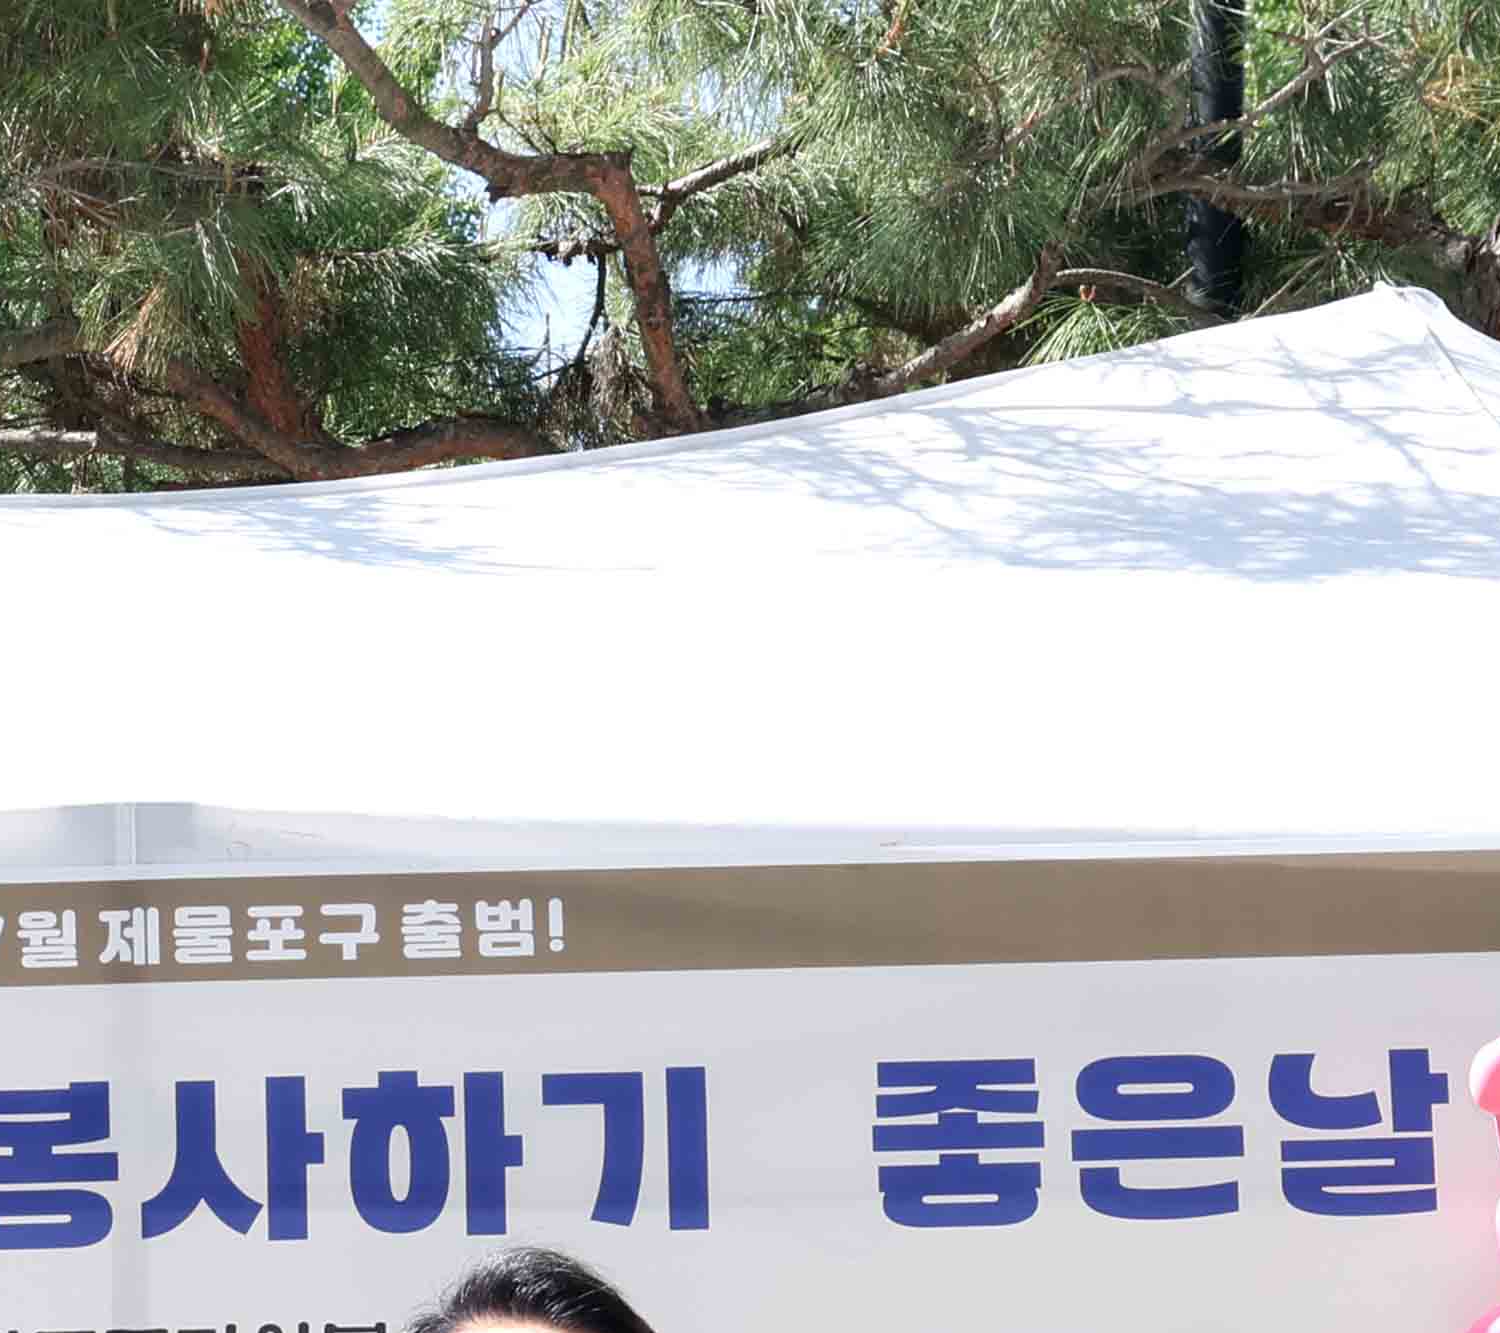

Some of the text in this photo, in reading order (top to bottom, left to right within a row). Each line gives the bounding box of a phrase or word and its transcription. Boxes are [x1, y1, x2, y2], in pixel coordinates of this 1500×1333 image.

[97, 901, 382, 968] 제물포구
[399, 897, 566, 959] 출범!
[871, 1046, 1449, 1230] 좋은날
